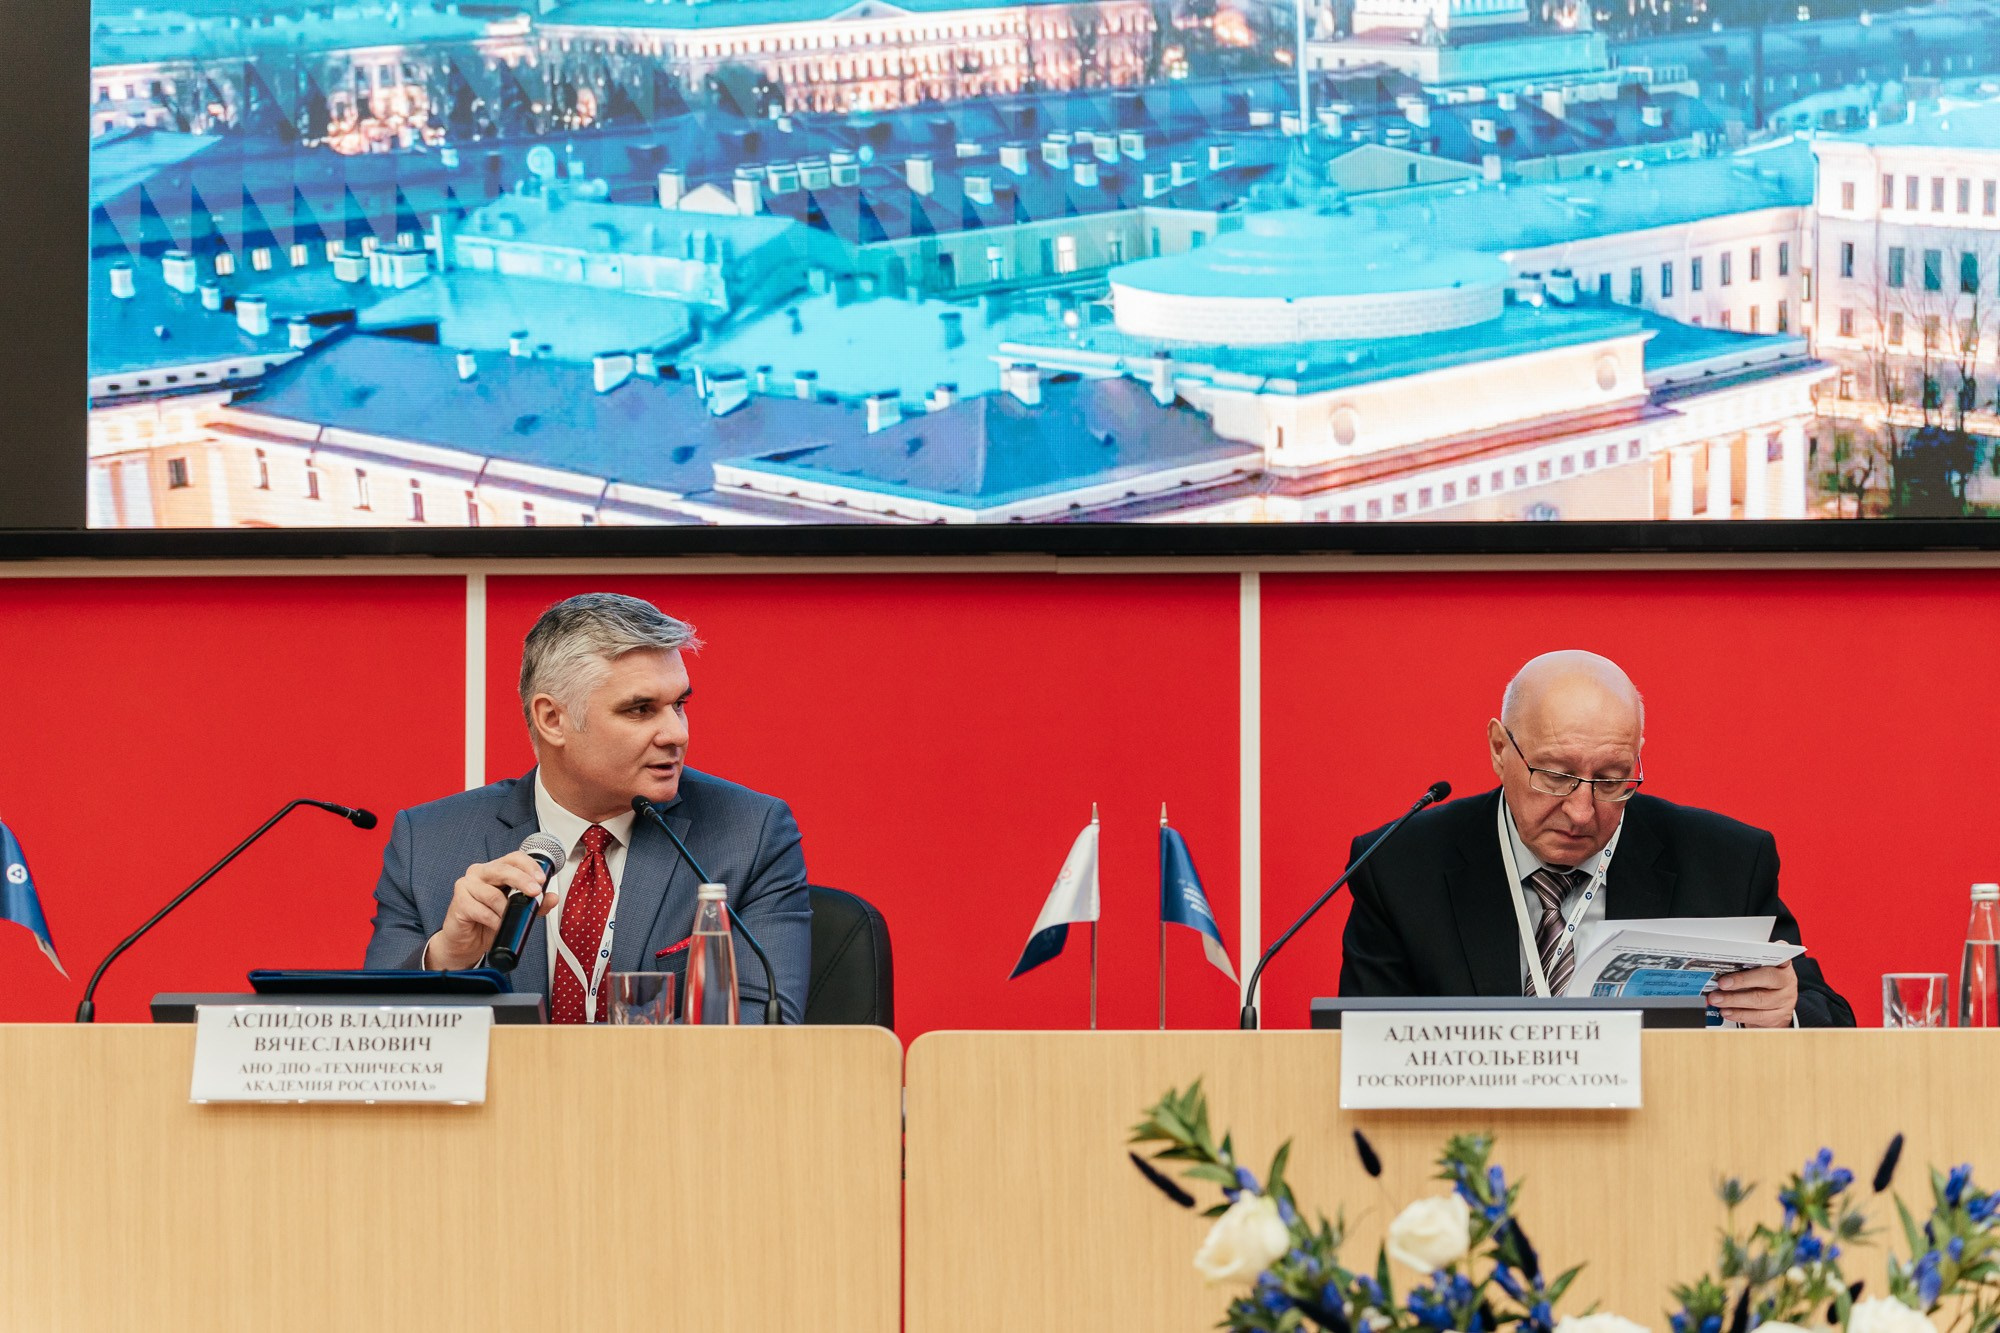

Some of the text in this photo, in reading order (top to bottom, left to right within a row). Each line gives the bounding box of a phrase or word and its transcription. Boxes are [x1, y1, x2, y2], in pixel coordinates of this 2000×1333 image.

[228, 1012, 462, 1030] АСПИДОВ ВЛАДИМИР
[1384, 1021, 1600, 1042] АДАМЧИК СЕРГЕЙ
[254, 1036, 432, 1052] ВЯЧЕСЛАВОВИЧ
[1404, 1050, 1579, 1066] АНАТОЛЬЕВИЧ
[239, 1062, 443, 1075] АНО ДПО «ТЕХНИЧЕСКАЯ
[242, 1080, 436, 1092] АКАДЕМИЯ РОСАТОМА»
[1357, 1074, 1628, 1088] ГОСКОРПОРАЦИИ «РОСАТОМ»
